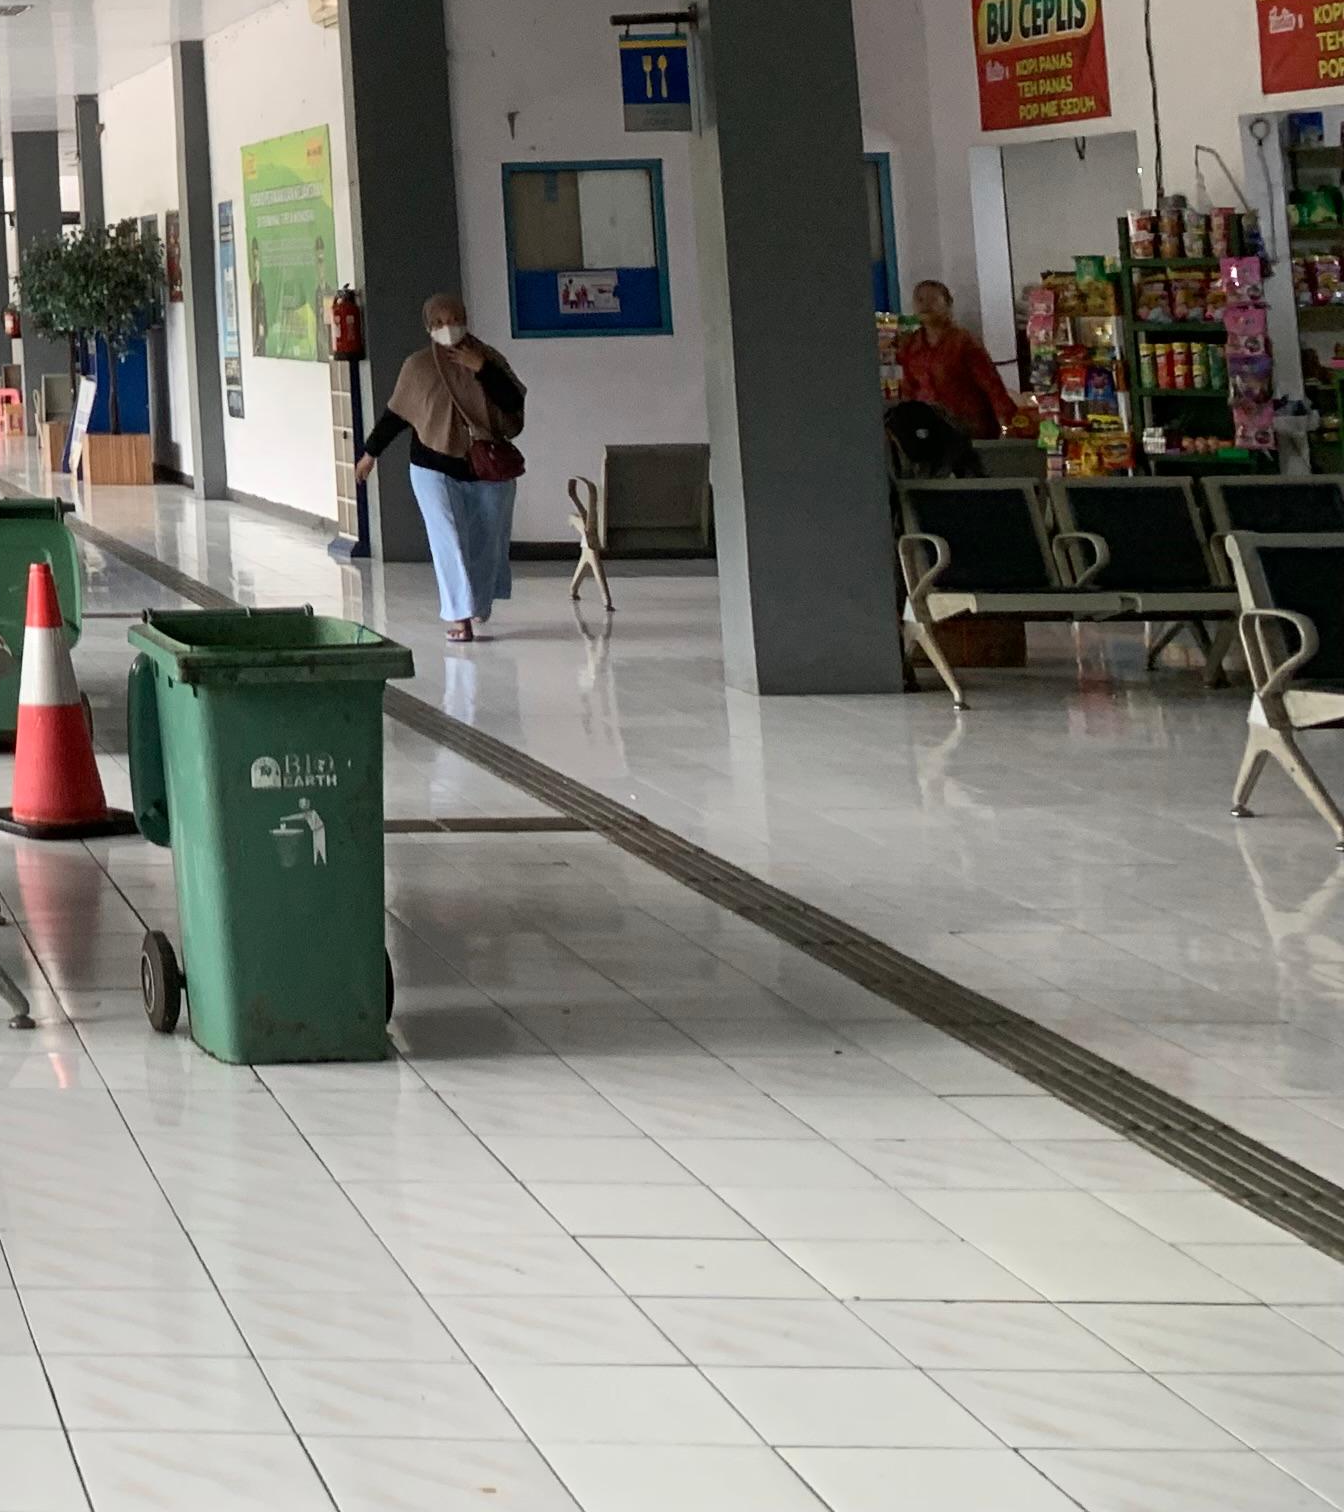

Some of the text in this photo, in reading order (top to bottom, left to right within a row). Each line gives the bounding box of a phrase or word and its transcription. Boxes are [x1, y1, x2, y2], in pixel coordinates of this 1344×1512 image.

[1015, 51, 1073, 77] KOPI PANAS
[1016, 74, 1073, 98] TEH PANAS
[1018, 95, 1097, 121] POP MIE SEDUH
[284, 774, 337, 788] EARTH
